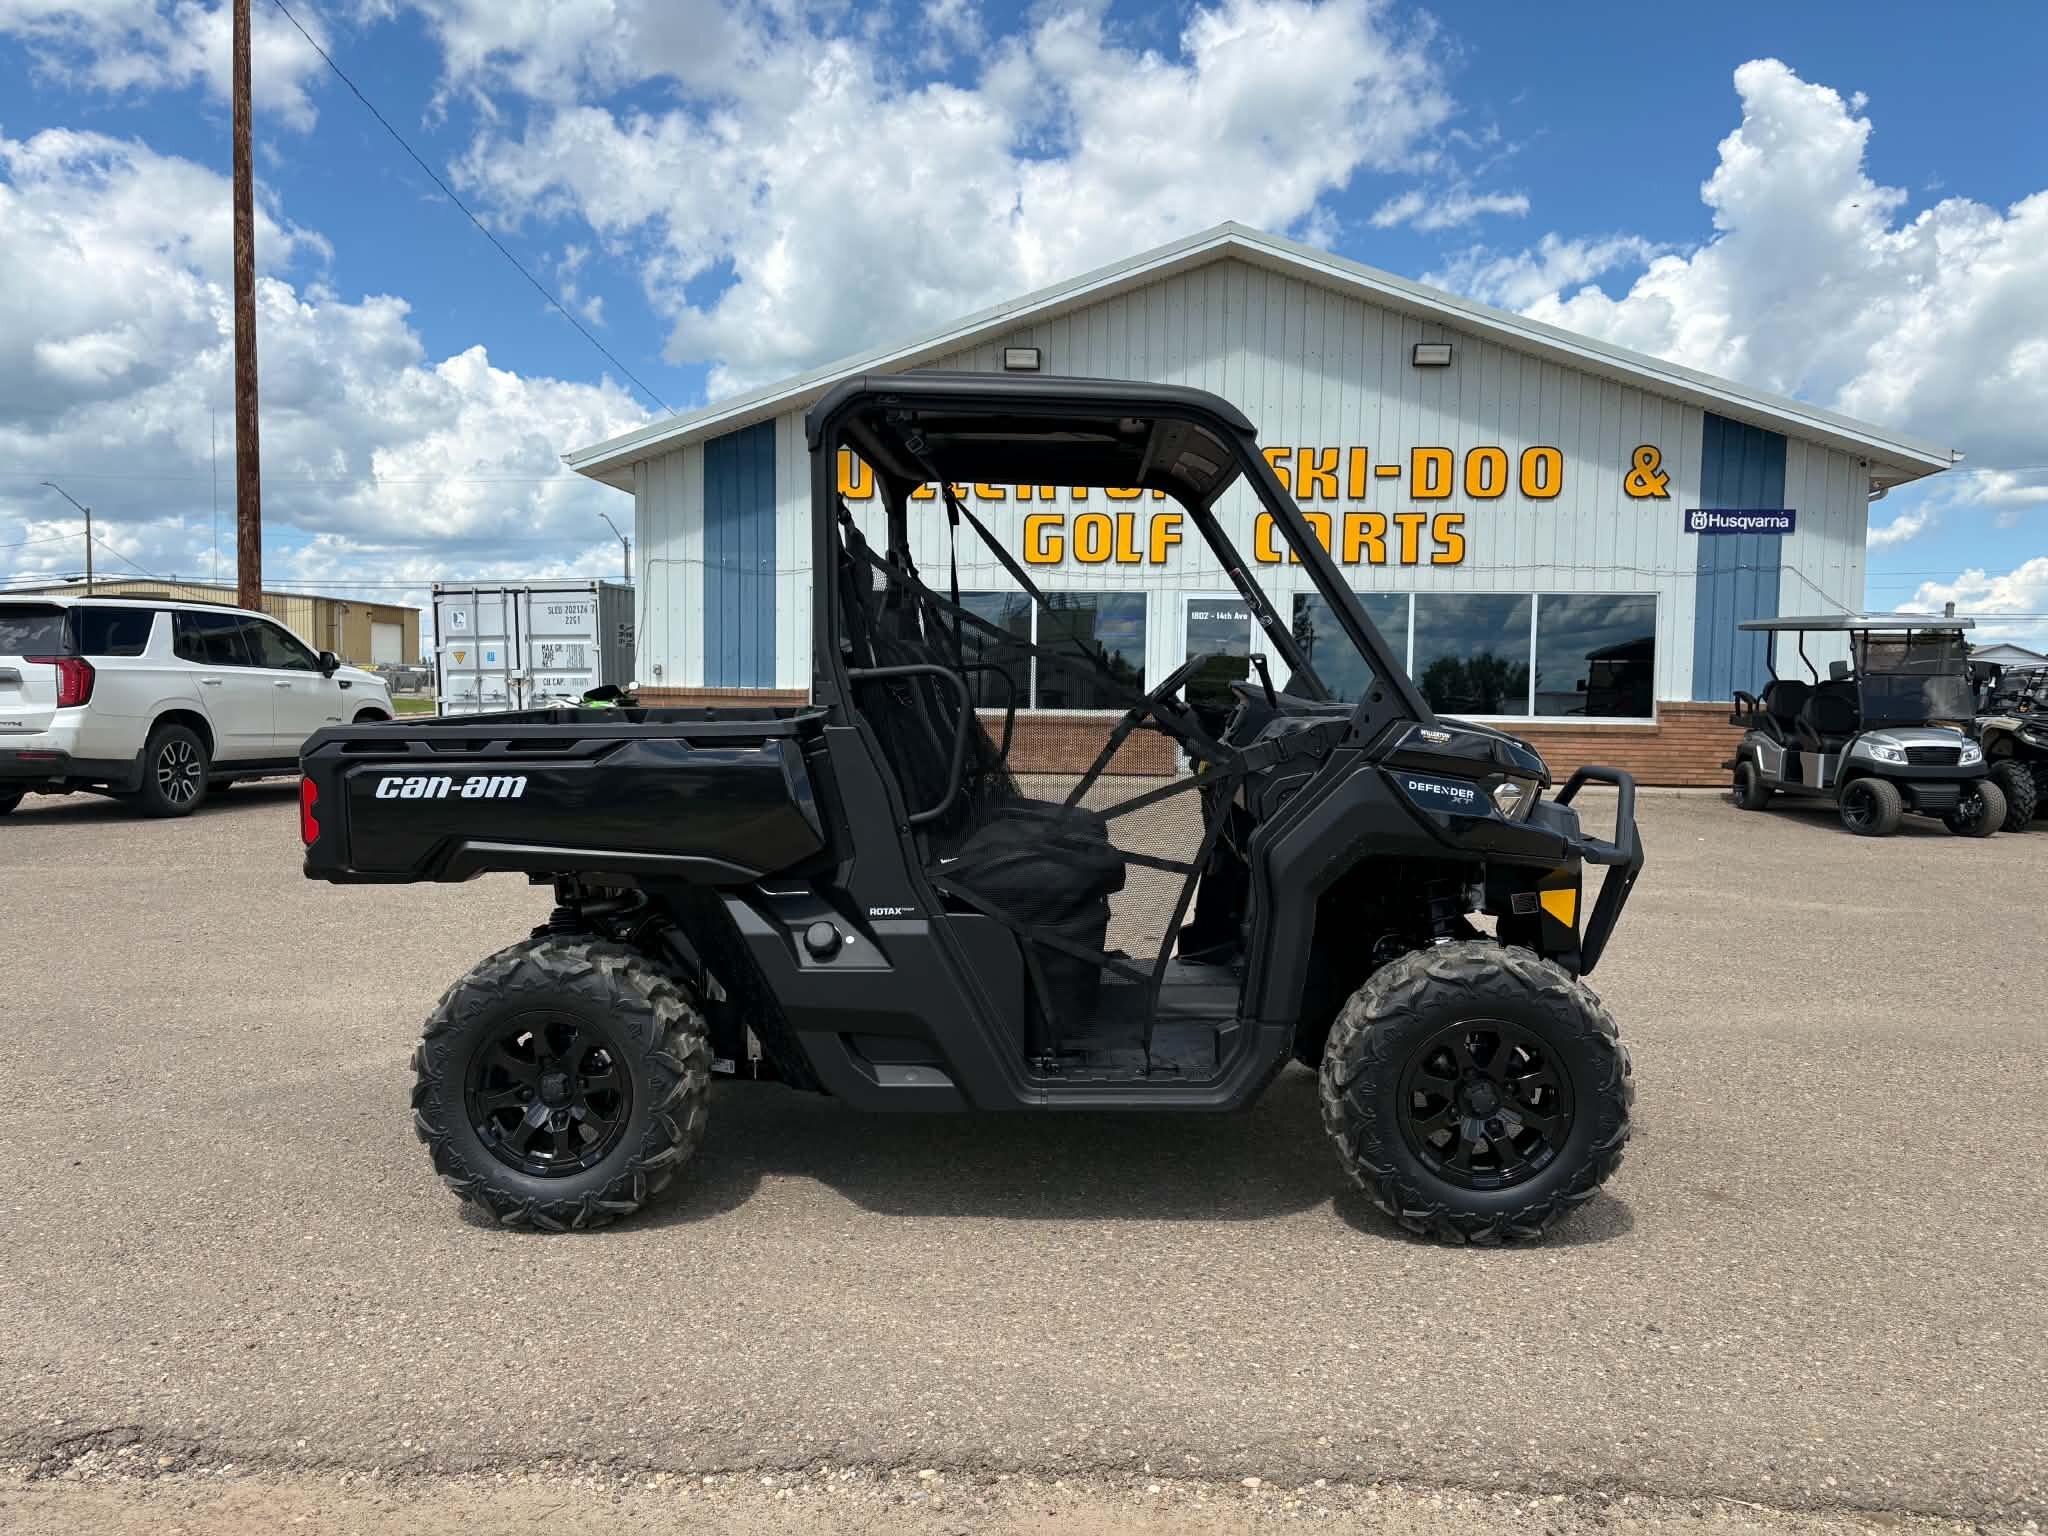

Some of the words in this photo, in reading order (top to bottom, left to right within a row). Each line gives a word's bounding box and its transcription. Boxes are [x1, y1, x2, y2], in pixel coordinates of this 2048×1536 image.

[1623, 445, 1670, 498] &
[1708, 513, 1789, 530] Husqvarna
[1024, 513, 1183, 564] GOLF
[1216, 611, 1232, 620] 14th
[1234, 611, 1248, 620] Ave
[375, 776, 528, 799] can-am
[1408, 780, 1474, 799] DEFENDER
[869, 907, 902, 916] ROTAX
